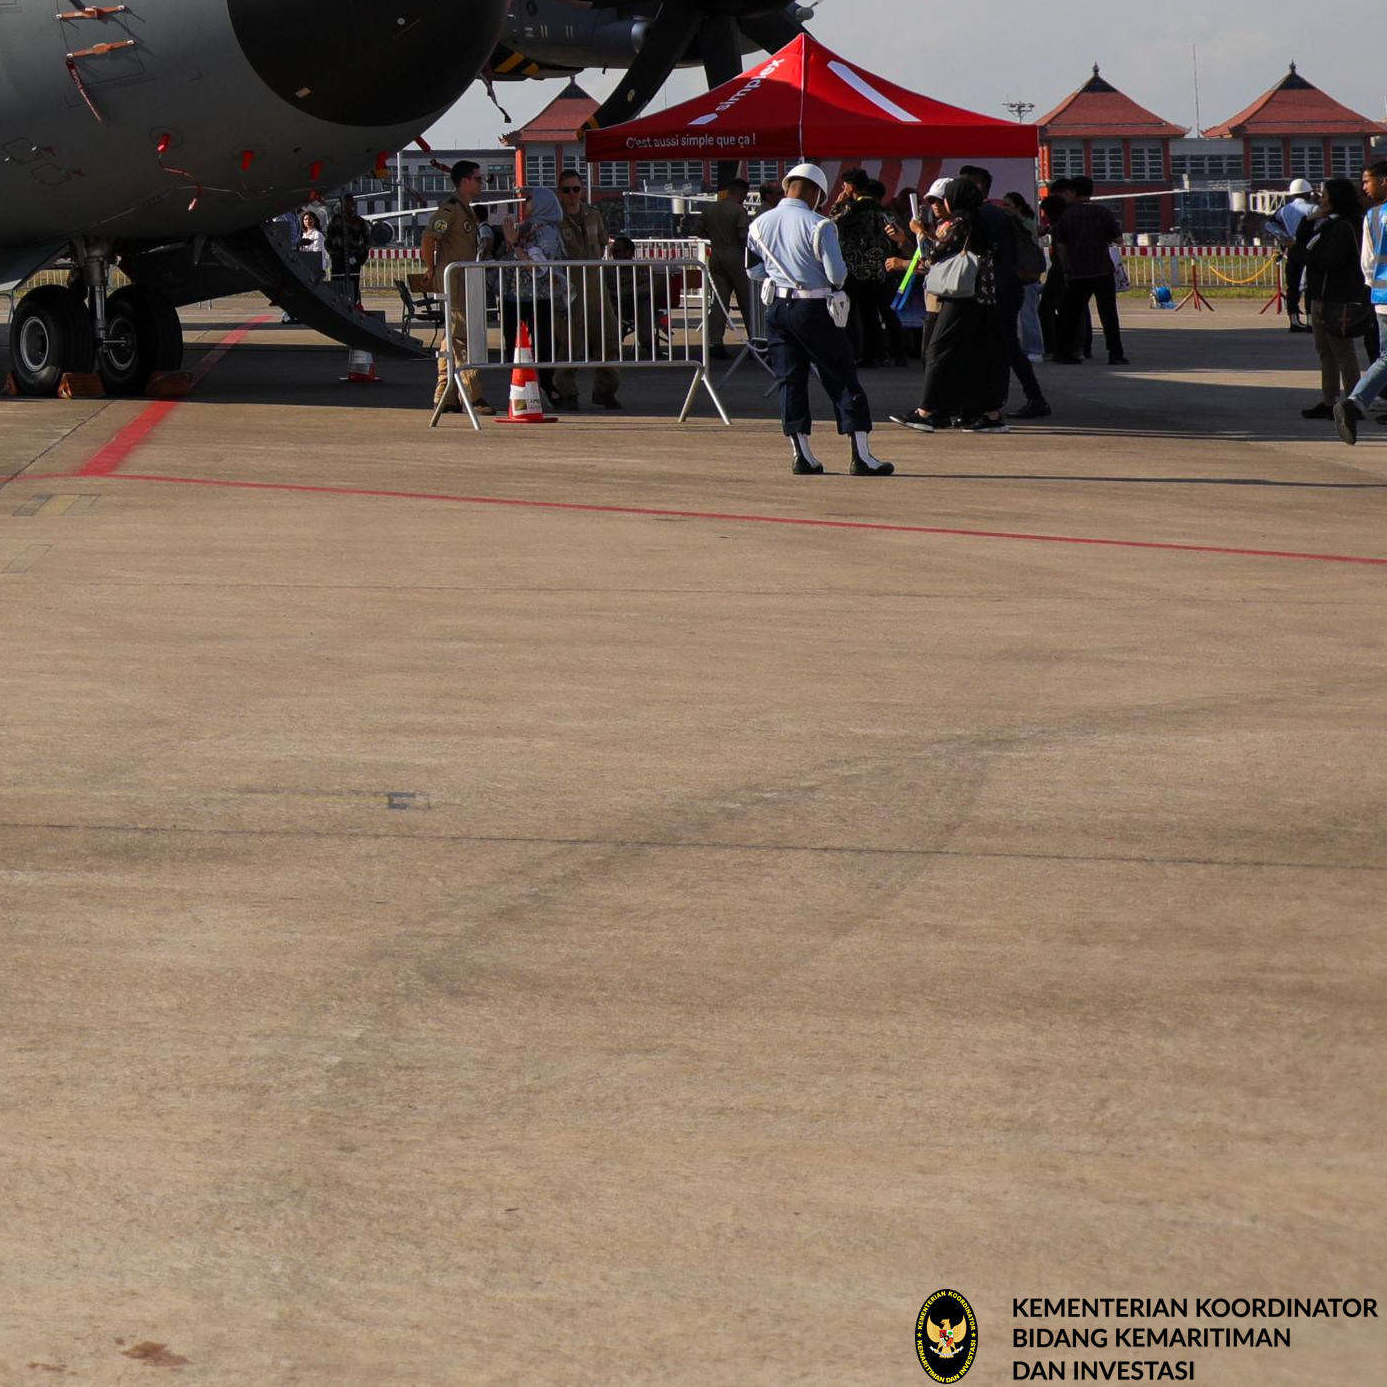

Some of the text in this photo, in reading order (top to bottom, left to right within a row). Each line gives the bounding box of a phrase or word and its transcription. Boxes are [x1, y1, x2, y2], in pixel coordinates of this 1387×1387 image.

[714, 58, 785, 113] simplex
[626, 135, 653, 149] C'est
[654, 134, 679, 148] aussi
[681, 132, 714, 149] simple
[716, 134, 736, 149] que
[737, 134, 751, 149] ça
